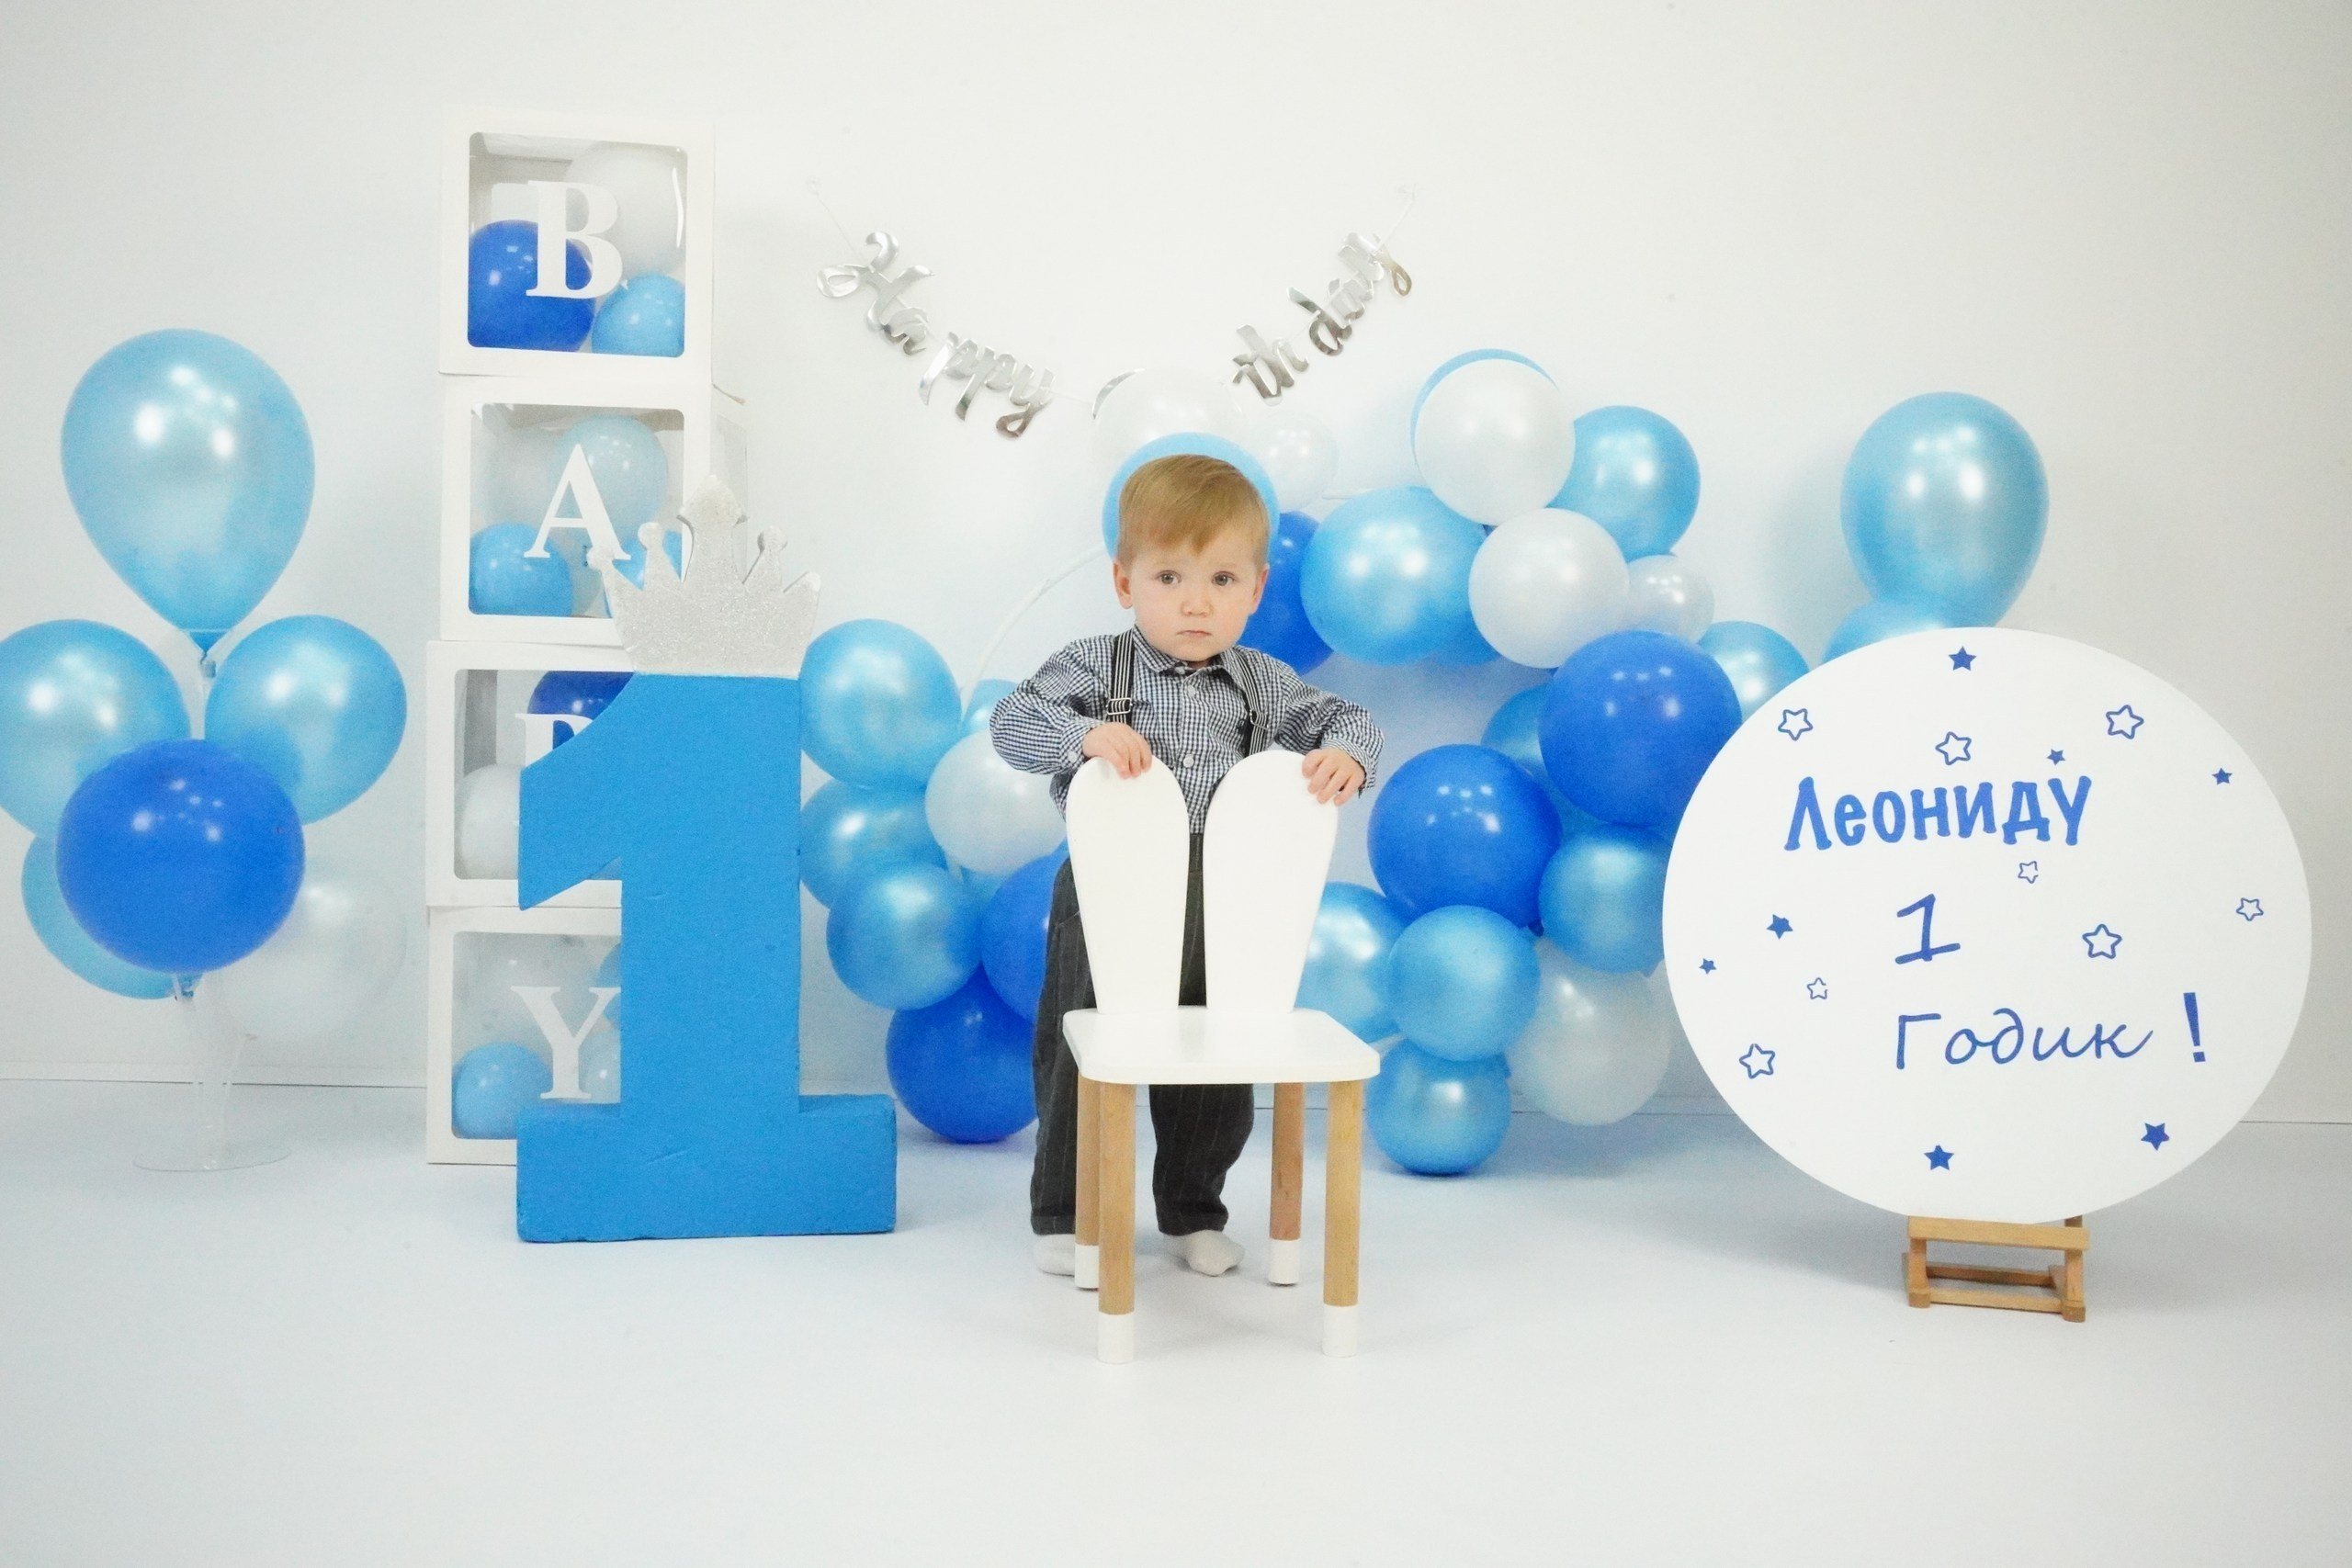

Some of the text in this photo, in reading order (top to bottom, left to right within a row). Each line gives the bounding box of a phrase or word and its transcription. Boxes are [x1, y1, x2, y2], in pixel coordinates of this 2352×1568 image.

[816, 231, 1055, 439] Happy
[1784, 775, 2092, 852] Леониду
[517, 672, 897, 1243] 1
[1894, 894, 1962, 964] 1
